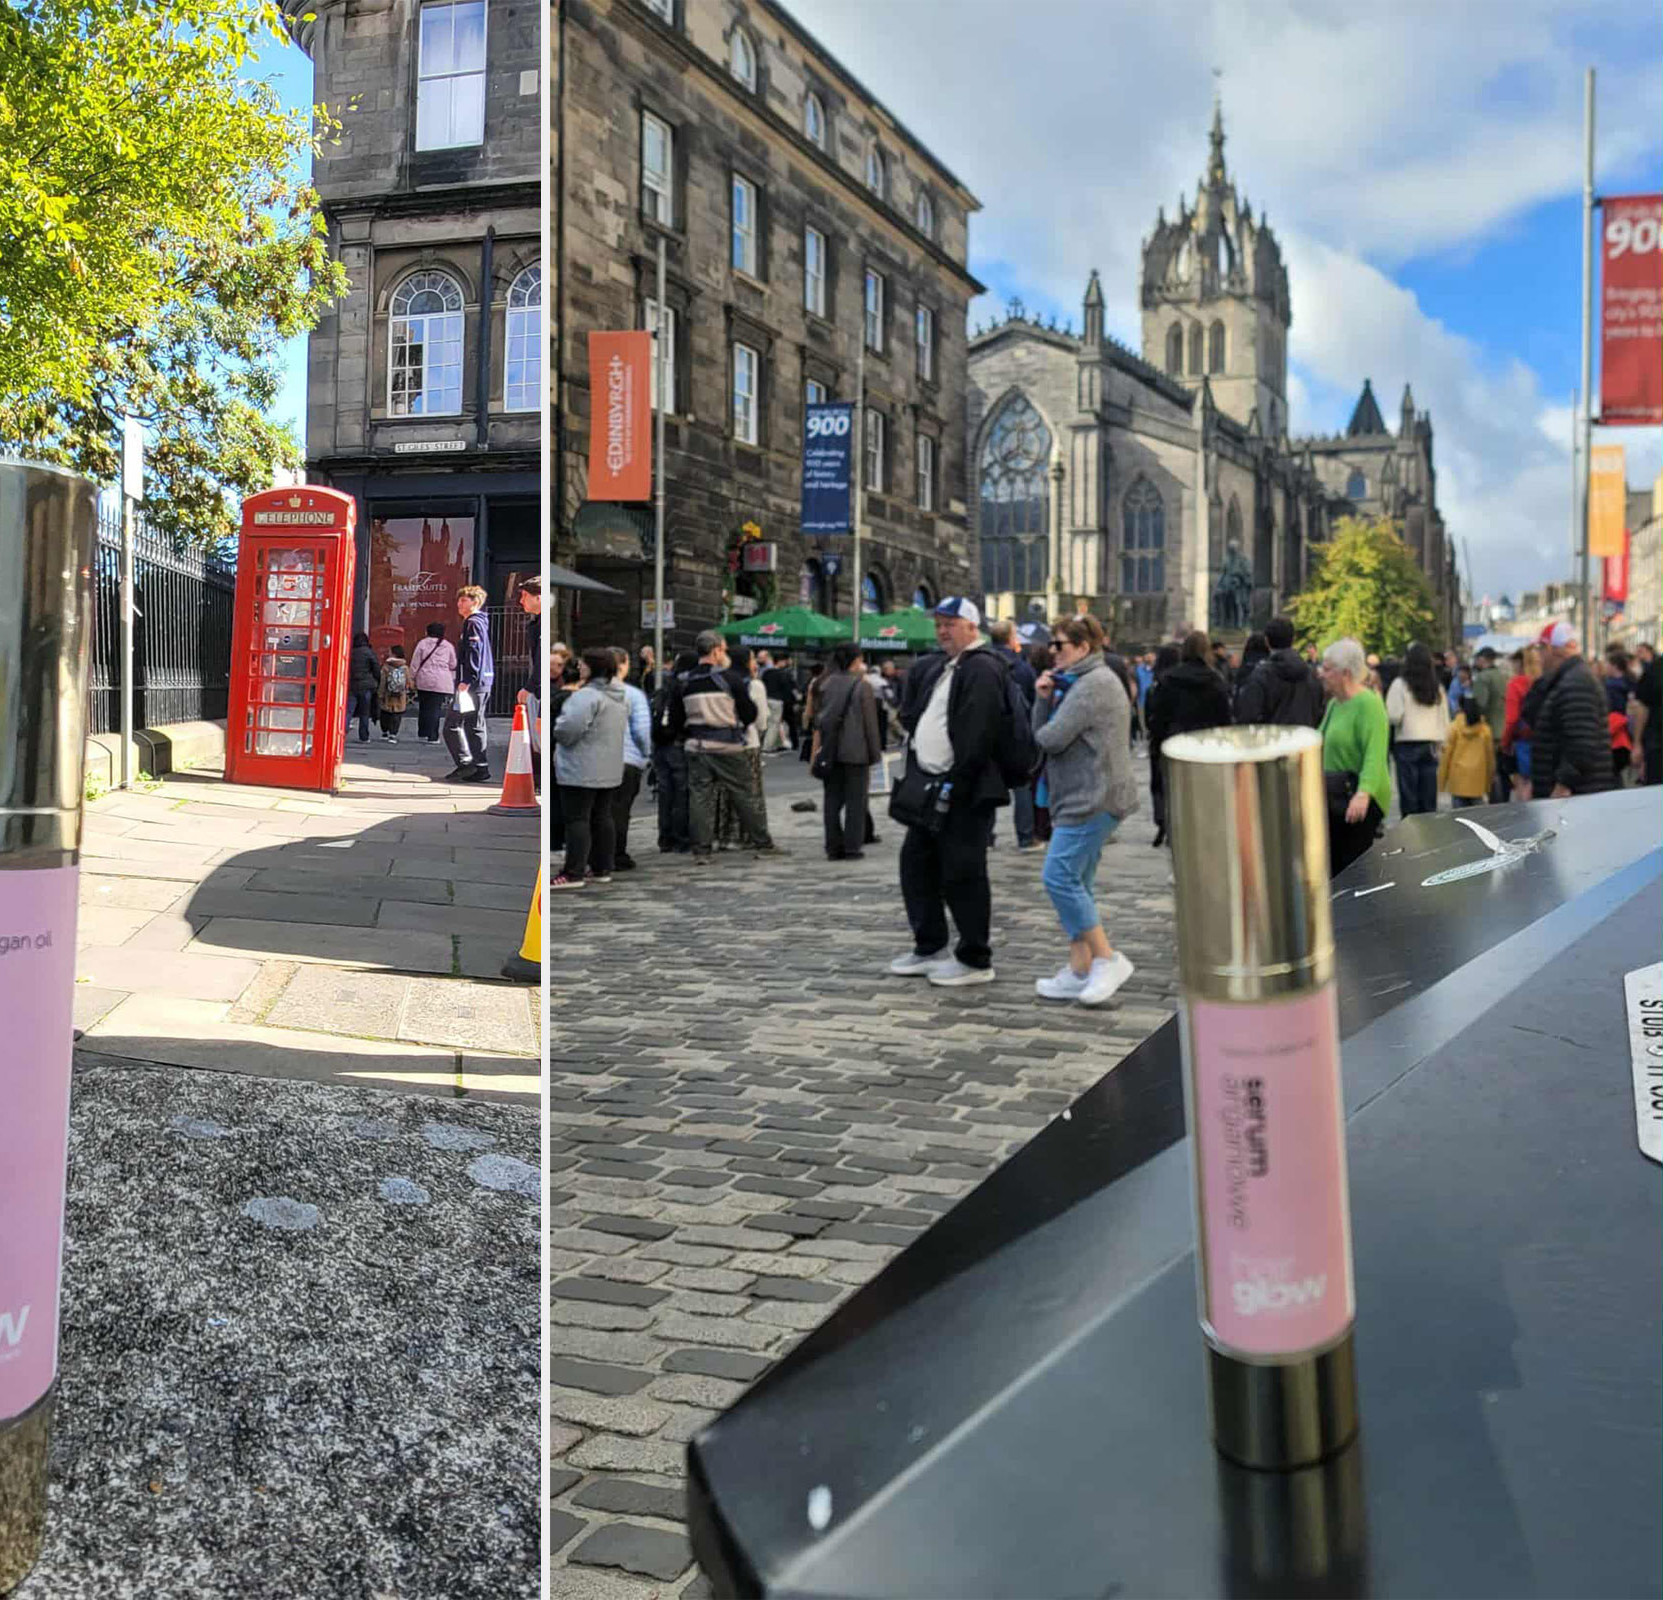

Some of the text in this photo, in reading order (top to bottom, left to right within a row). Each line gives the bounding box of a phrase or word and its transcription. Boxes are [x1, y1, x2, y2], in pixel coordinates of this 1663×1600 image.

[1606, 217, 1660, 259] 90
[807, 415, 850, 438] 900
[35, 929, 53, 948] oil
[1233, 1273, 1328, 1316] glow
